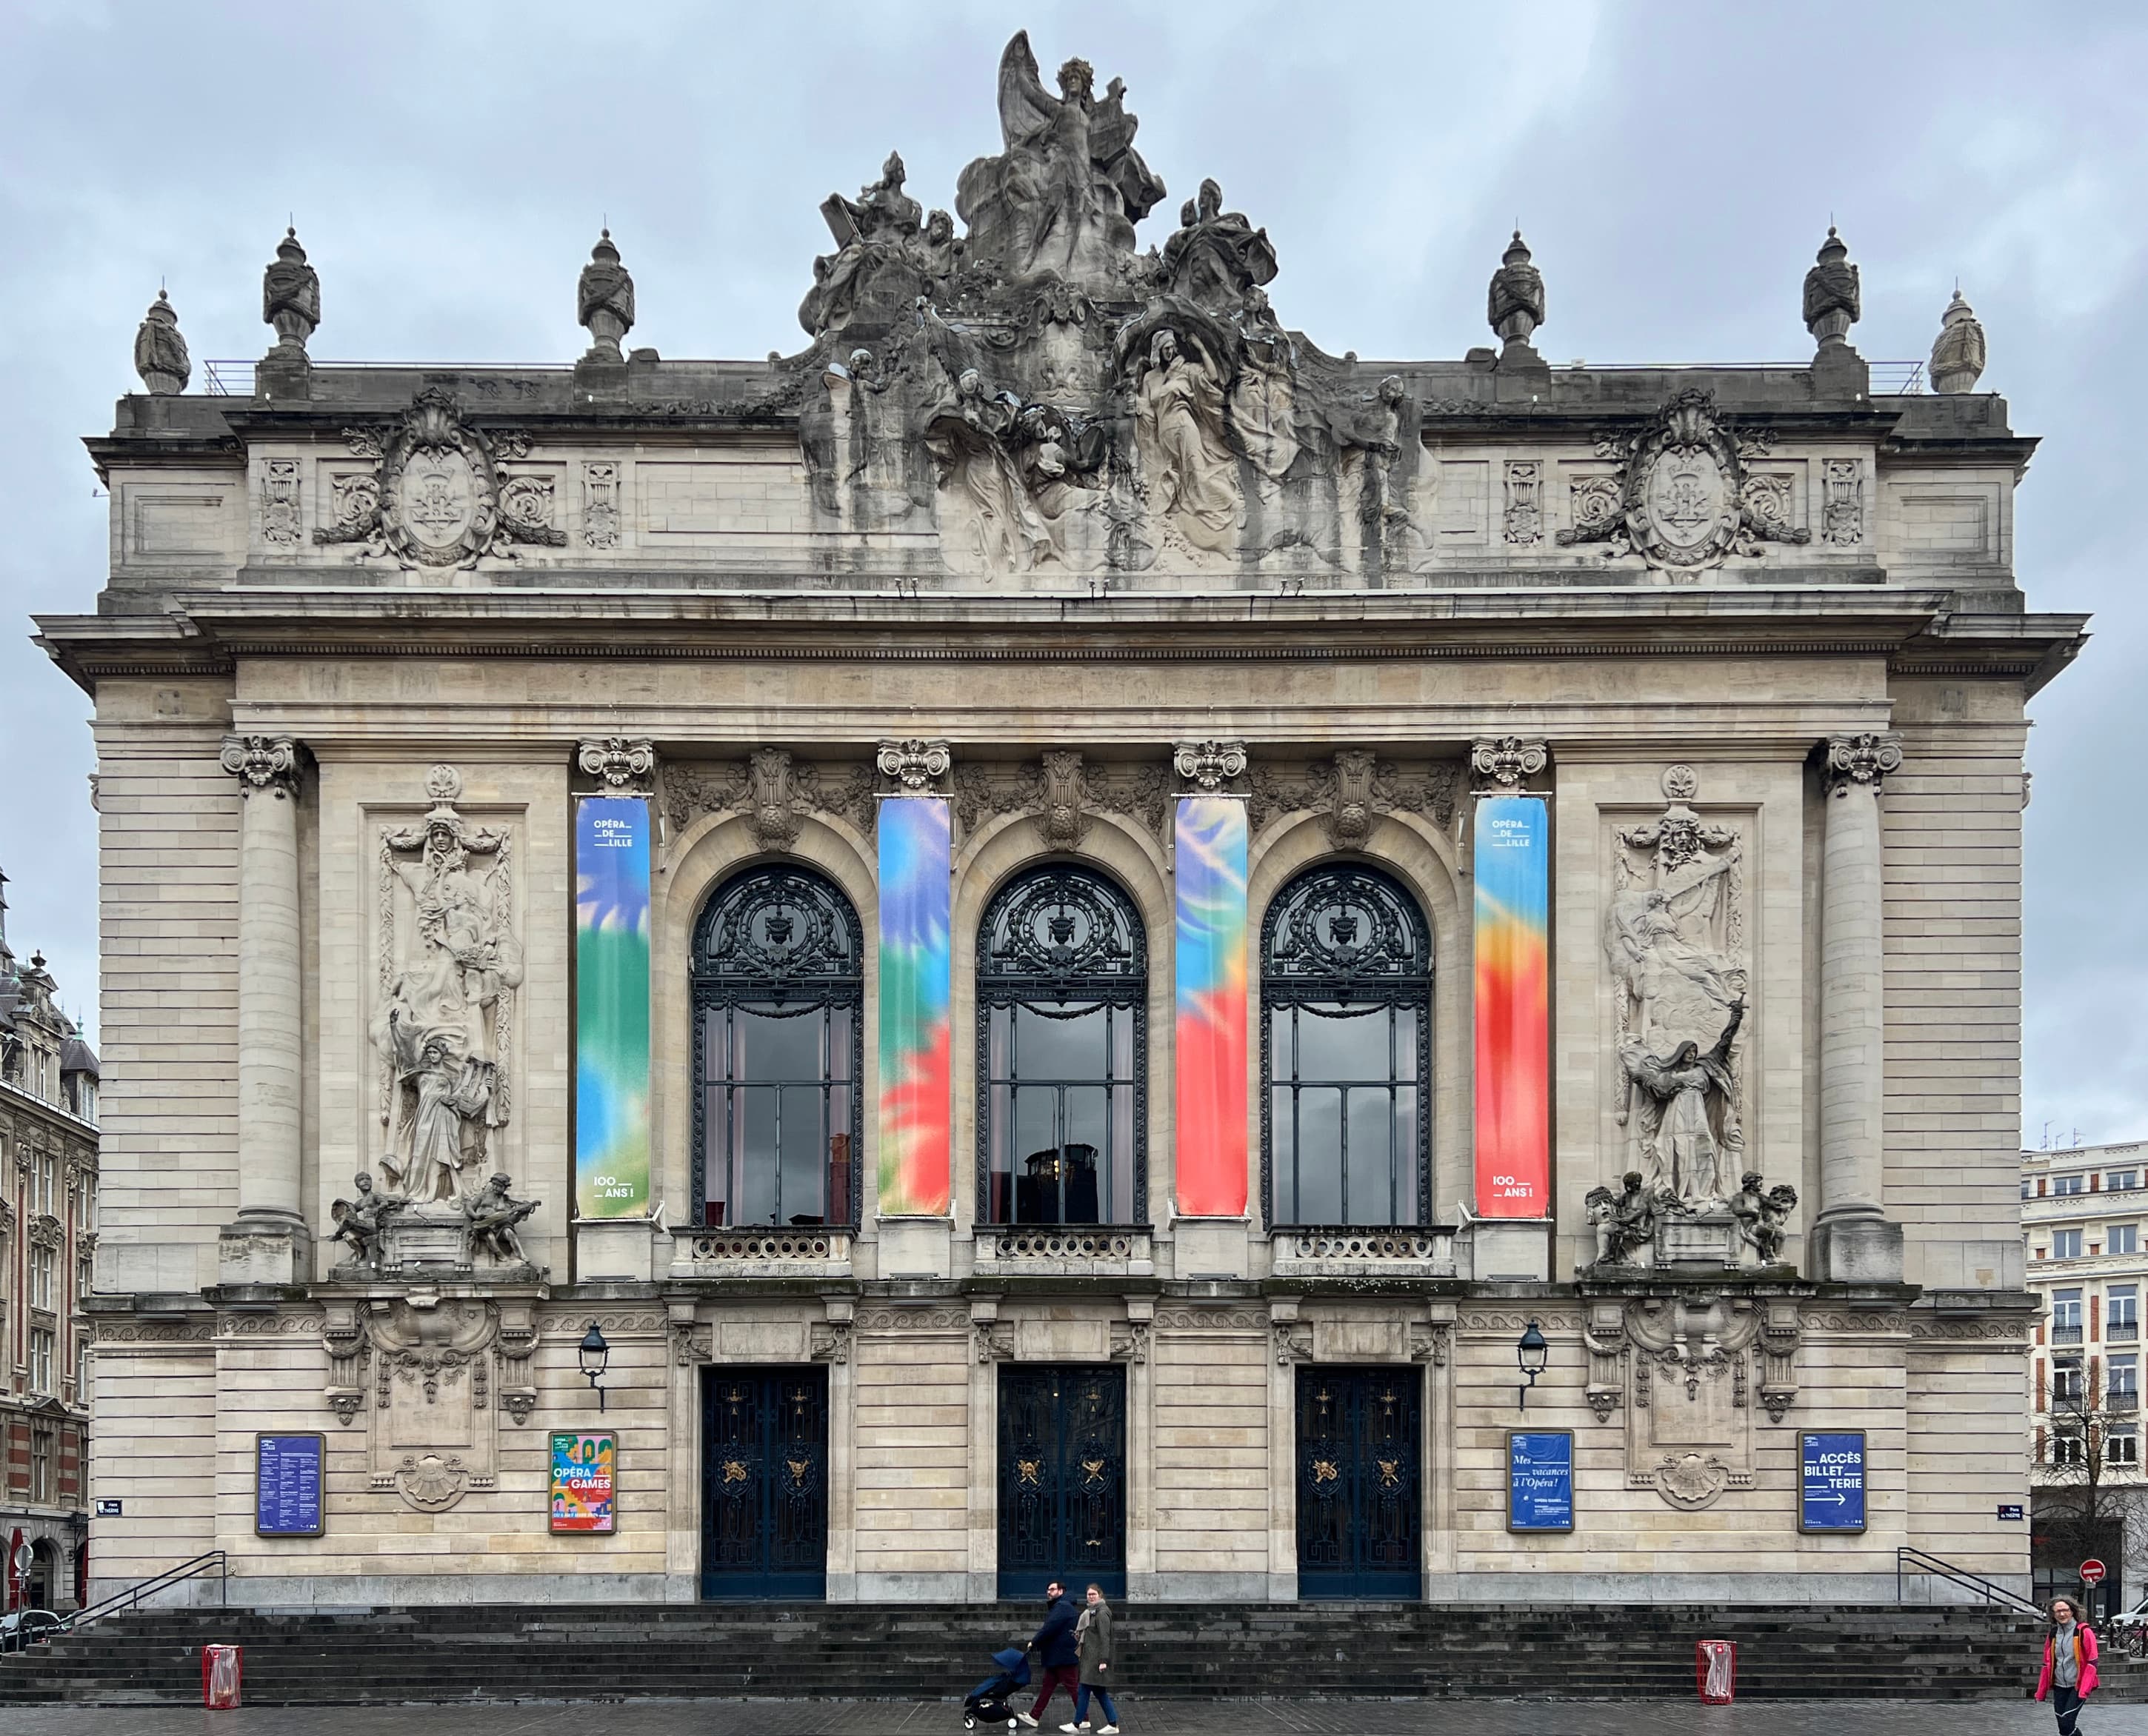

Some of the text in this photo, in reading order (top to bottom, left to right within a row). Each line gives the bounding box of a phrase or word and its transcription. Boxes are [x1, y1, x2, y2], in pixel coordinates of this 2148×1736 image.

[594, 818, 625, 828] OPÉRA
[1492, 819, 1523, 828] OPÉRA
[602, 829, 614, 838] DE
[593, 1176, 616, 1186] 100
[1492, 1175, 1515, 1186] 100
[604, 1188, 628, 1198] ANS
[1504, 1187, 1527, 1198] ANS
[1513, 1455, 1532, 1464] Mes
[1819, 1451, 1861, 1463] ACCÈS
[553, 1466, 591, 1478] OPÉRA
[1804, 1466, 1844, 1476] BILLET
[571, 1479, 611, 1489] GAMES
[1512, 1478, 1519, 1487] à
[1828, 1478, 1862, 1489] TERIE
